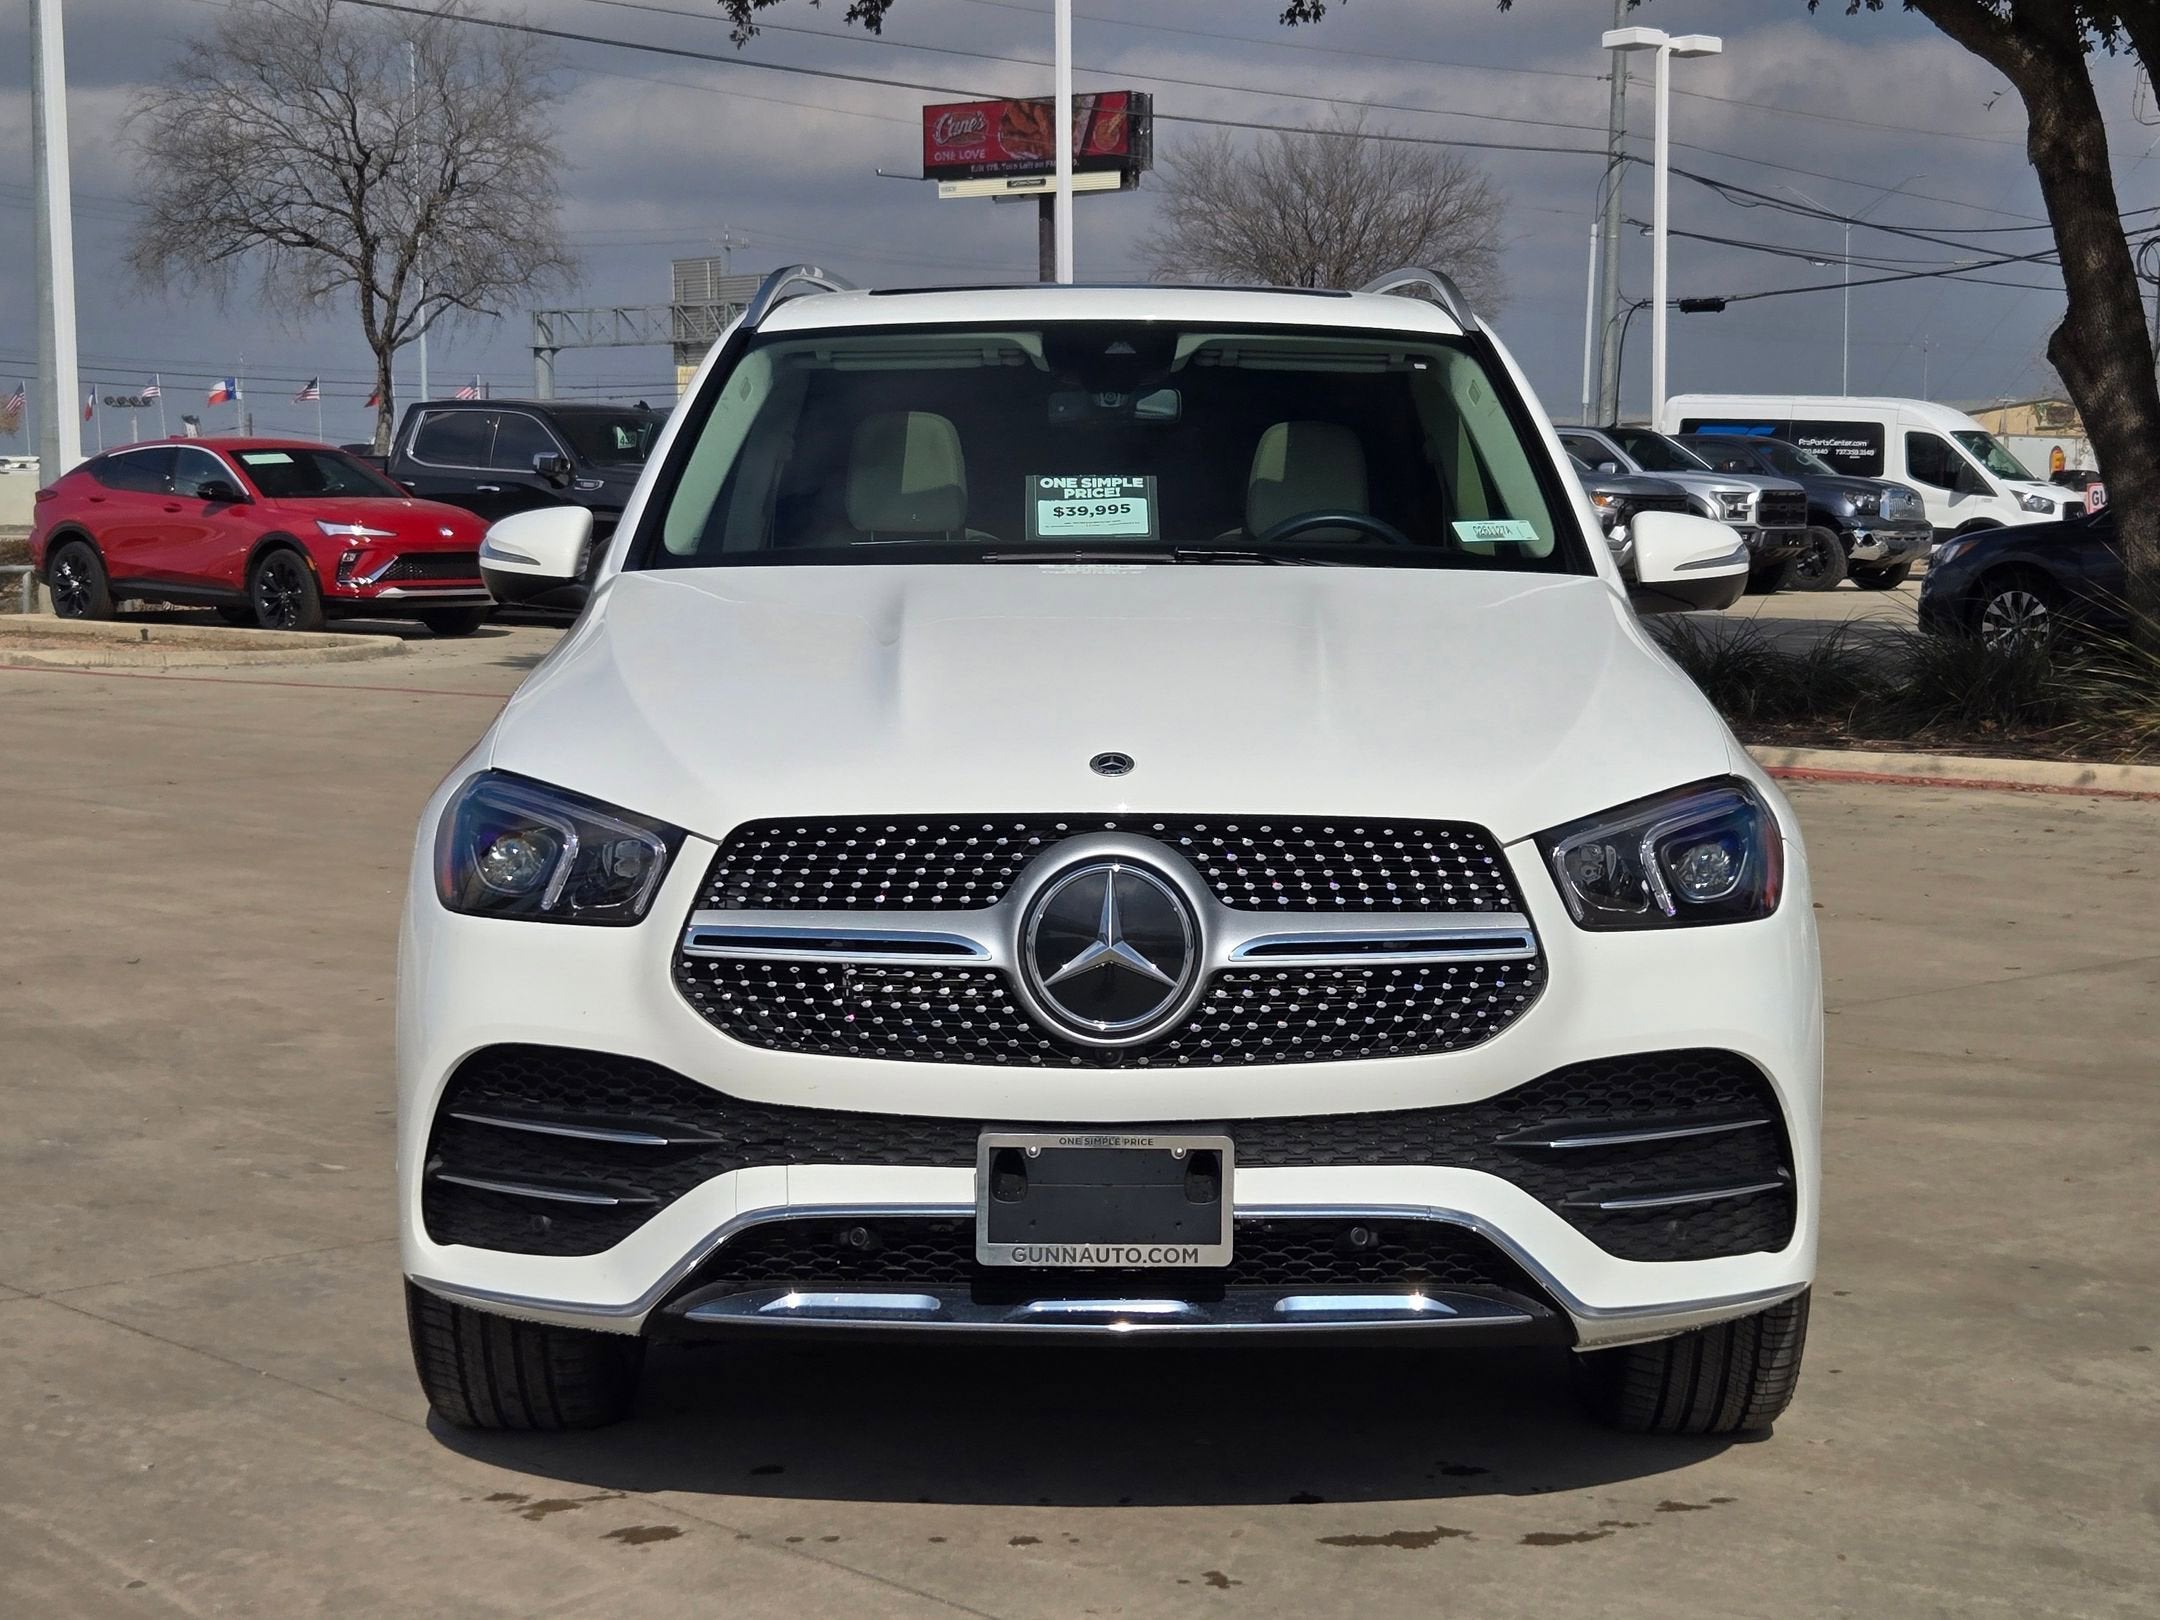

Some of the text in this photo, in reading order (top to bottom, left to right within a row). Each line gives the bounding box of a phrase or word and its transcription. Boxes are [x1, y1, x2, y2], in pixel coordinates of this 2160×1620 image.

[934, 148, 986, 161] ONE LOVE
[1798, 438, 1868, 447] ProPartsCenter.com
[1040, 477, 1144, 488] ONE SIMPLE
[1064, 487, 1121, 499] PRICE!
[1053, 503, 1131, 518] $39,995
[1058, 1137, 1154, 1146] ONE SIMPLE PRICE
[1011, 1247, 1199, 1264] GUNNAUTO.COM
